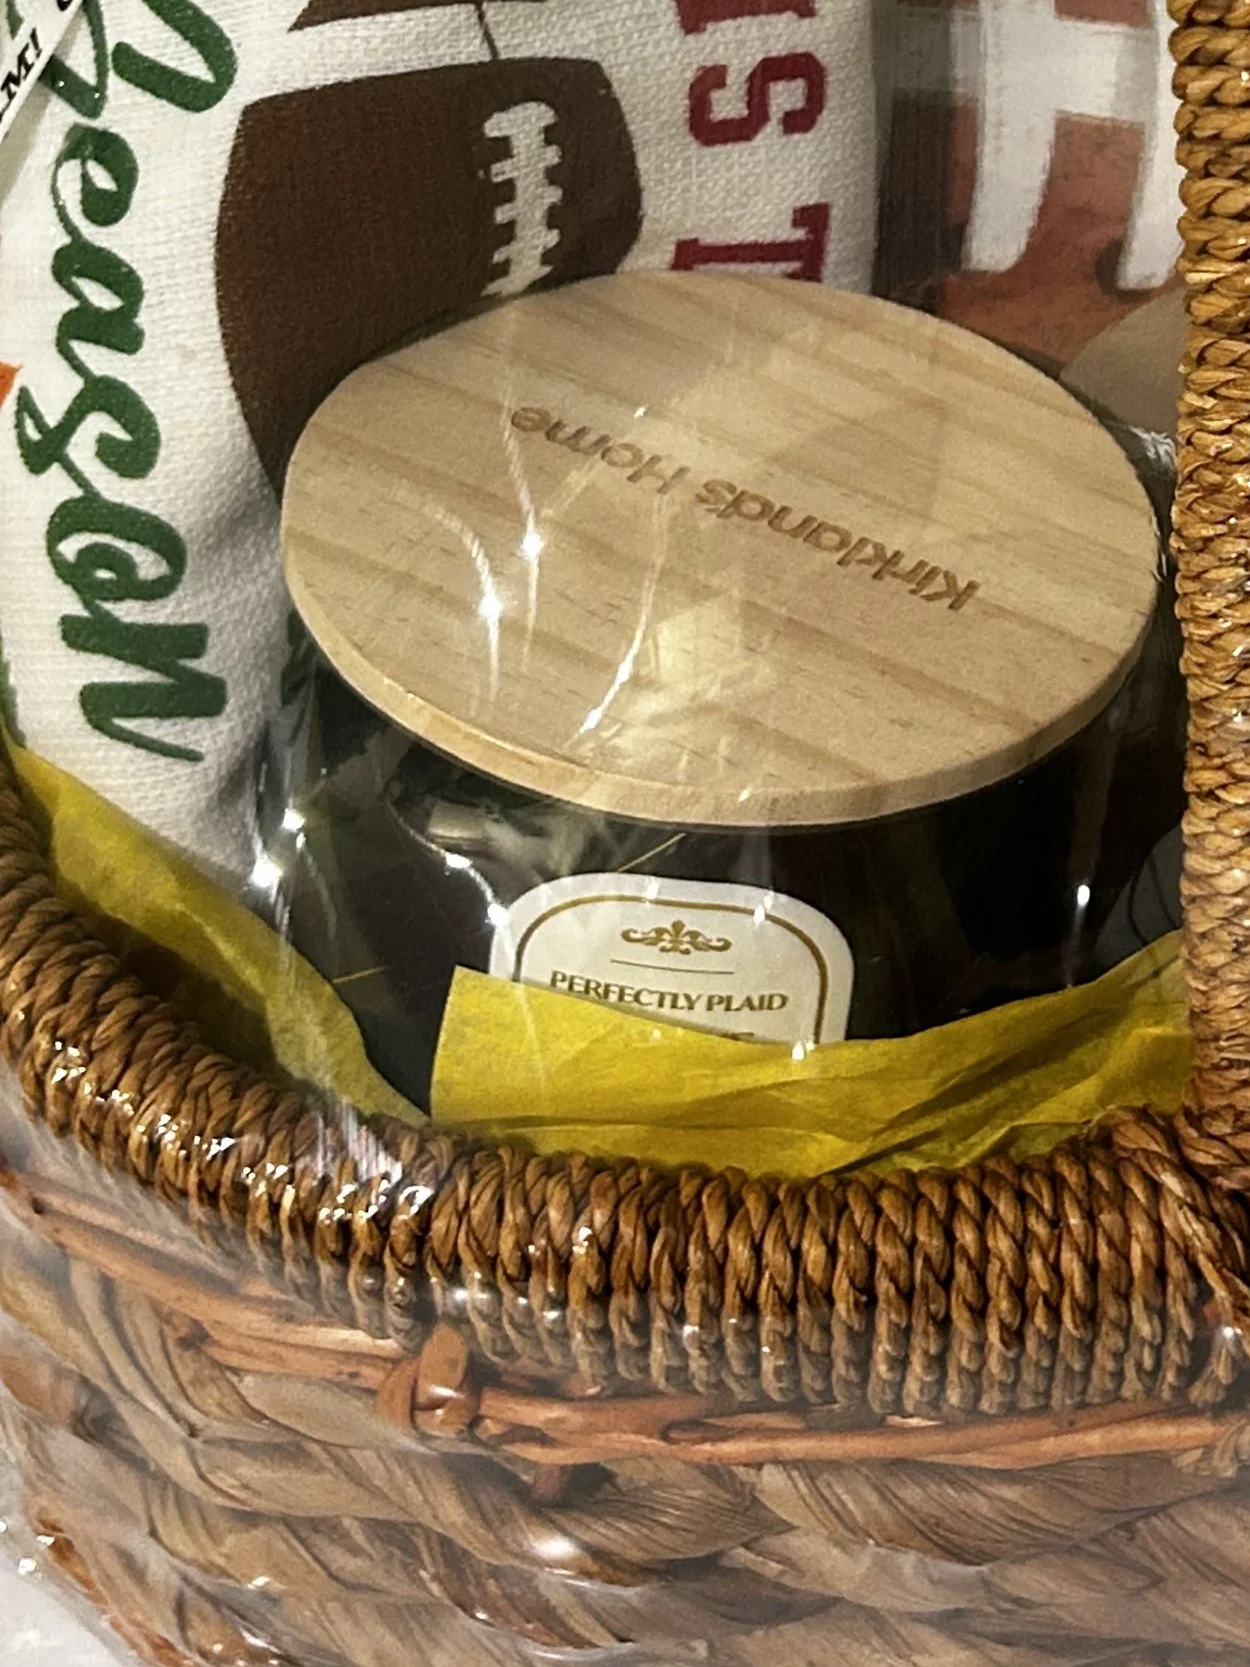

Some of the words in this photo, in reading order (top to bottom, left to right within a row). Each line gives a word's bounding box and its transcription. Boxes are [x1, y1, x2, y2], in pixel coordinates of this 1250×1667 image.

[511, 405, 691, 495] Home
[550, 969, 702, 1012] PERFECTLY
[705, 992, 789, 1013] PLAID
